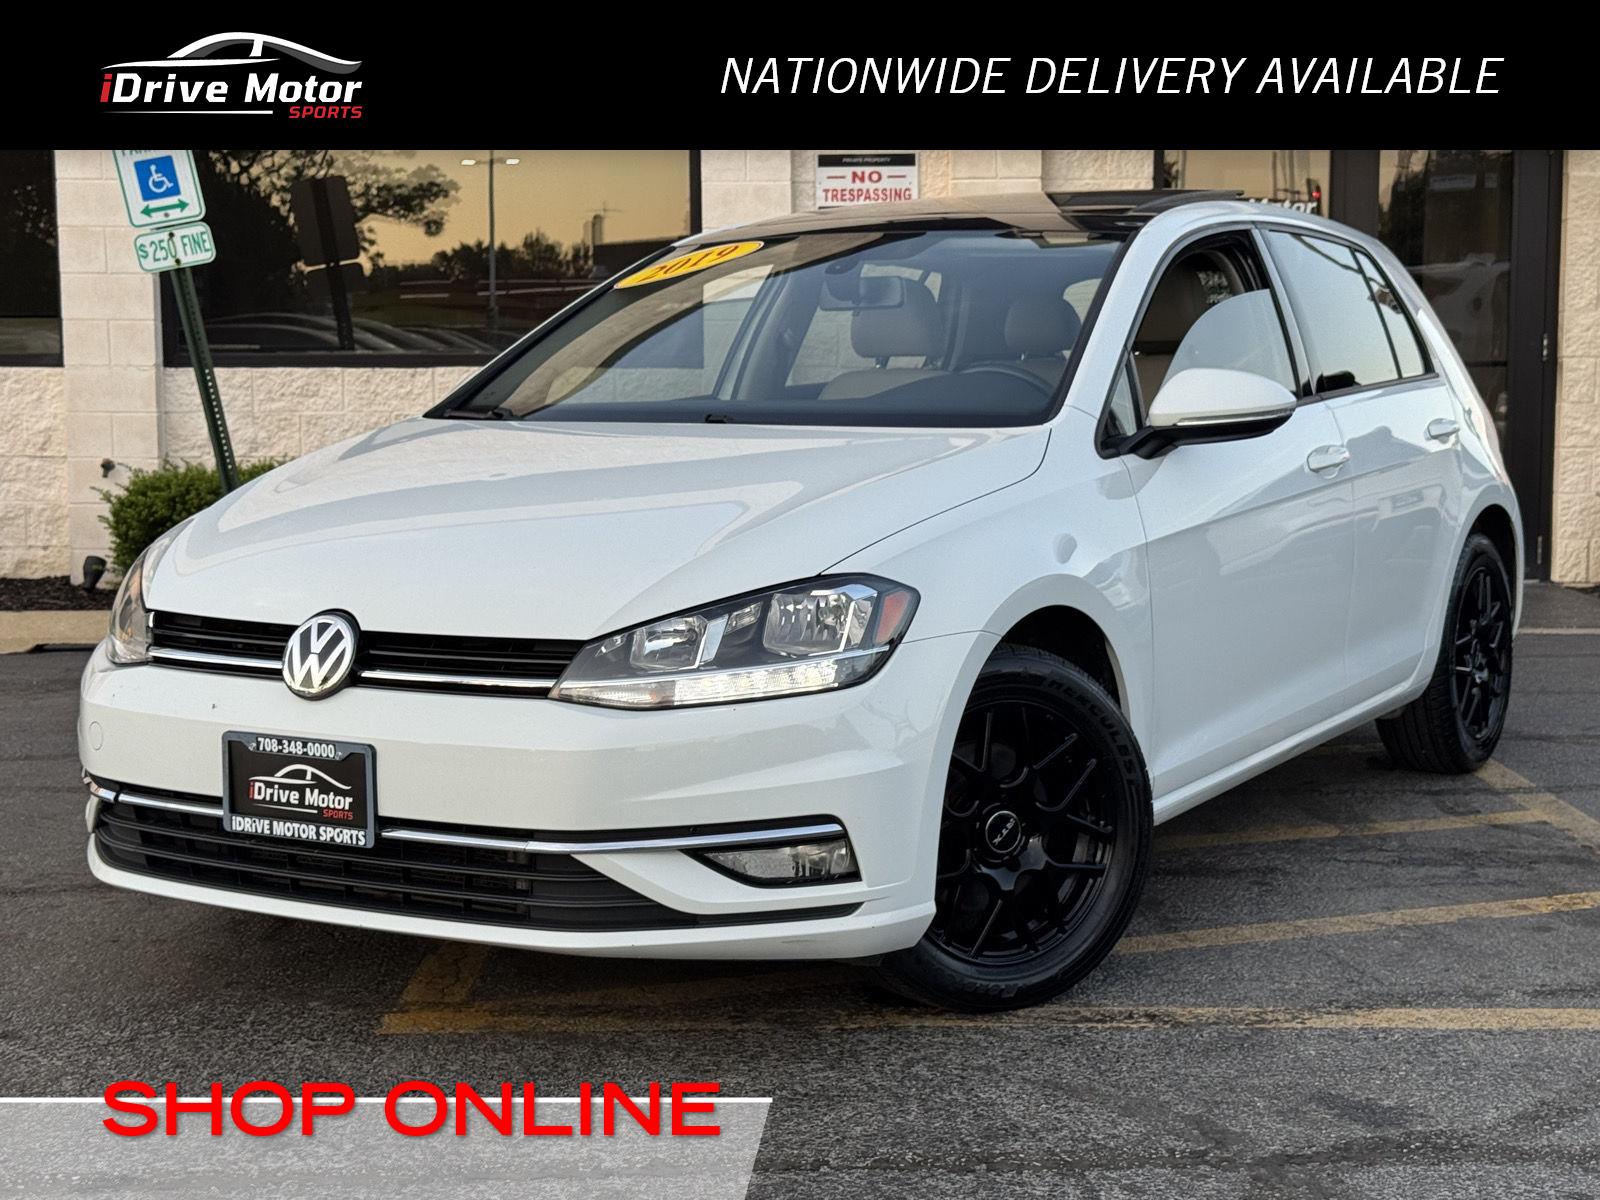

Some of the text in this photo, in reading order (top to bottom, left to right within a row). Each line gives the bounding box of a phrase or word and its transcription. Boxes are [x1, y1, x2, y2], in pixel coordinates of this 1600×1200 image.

[851, 170, 882, 184] NO
[822, 187, 912, 203] TRESPASSING
[1248, 197, 1318, 214] tor
[180, 231, 212, 257] FINE
[638, 244, 740, 283] 2019
[257, 737, 335, 757] 708-348-0000
[248, 781, 353, 810] iDrive Motor
[322, 808, 353, 821] SPORTS
[272, 820, 317, 841] MOTOR
[319, 825, 366, 847] SPORTS
